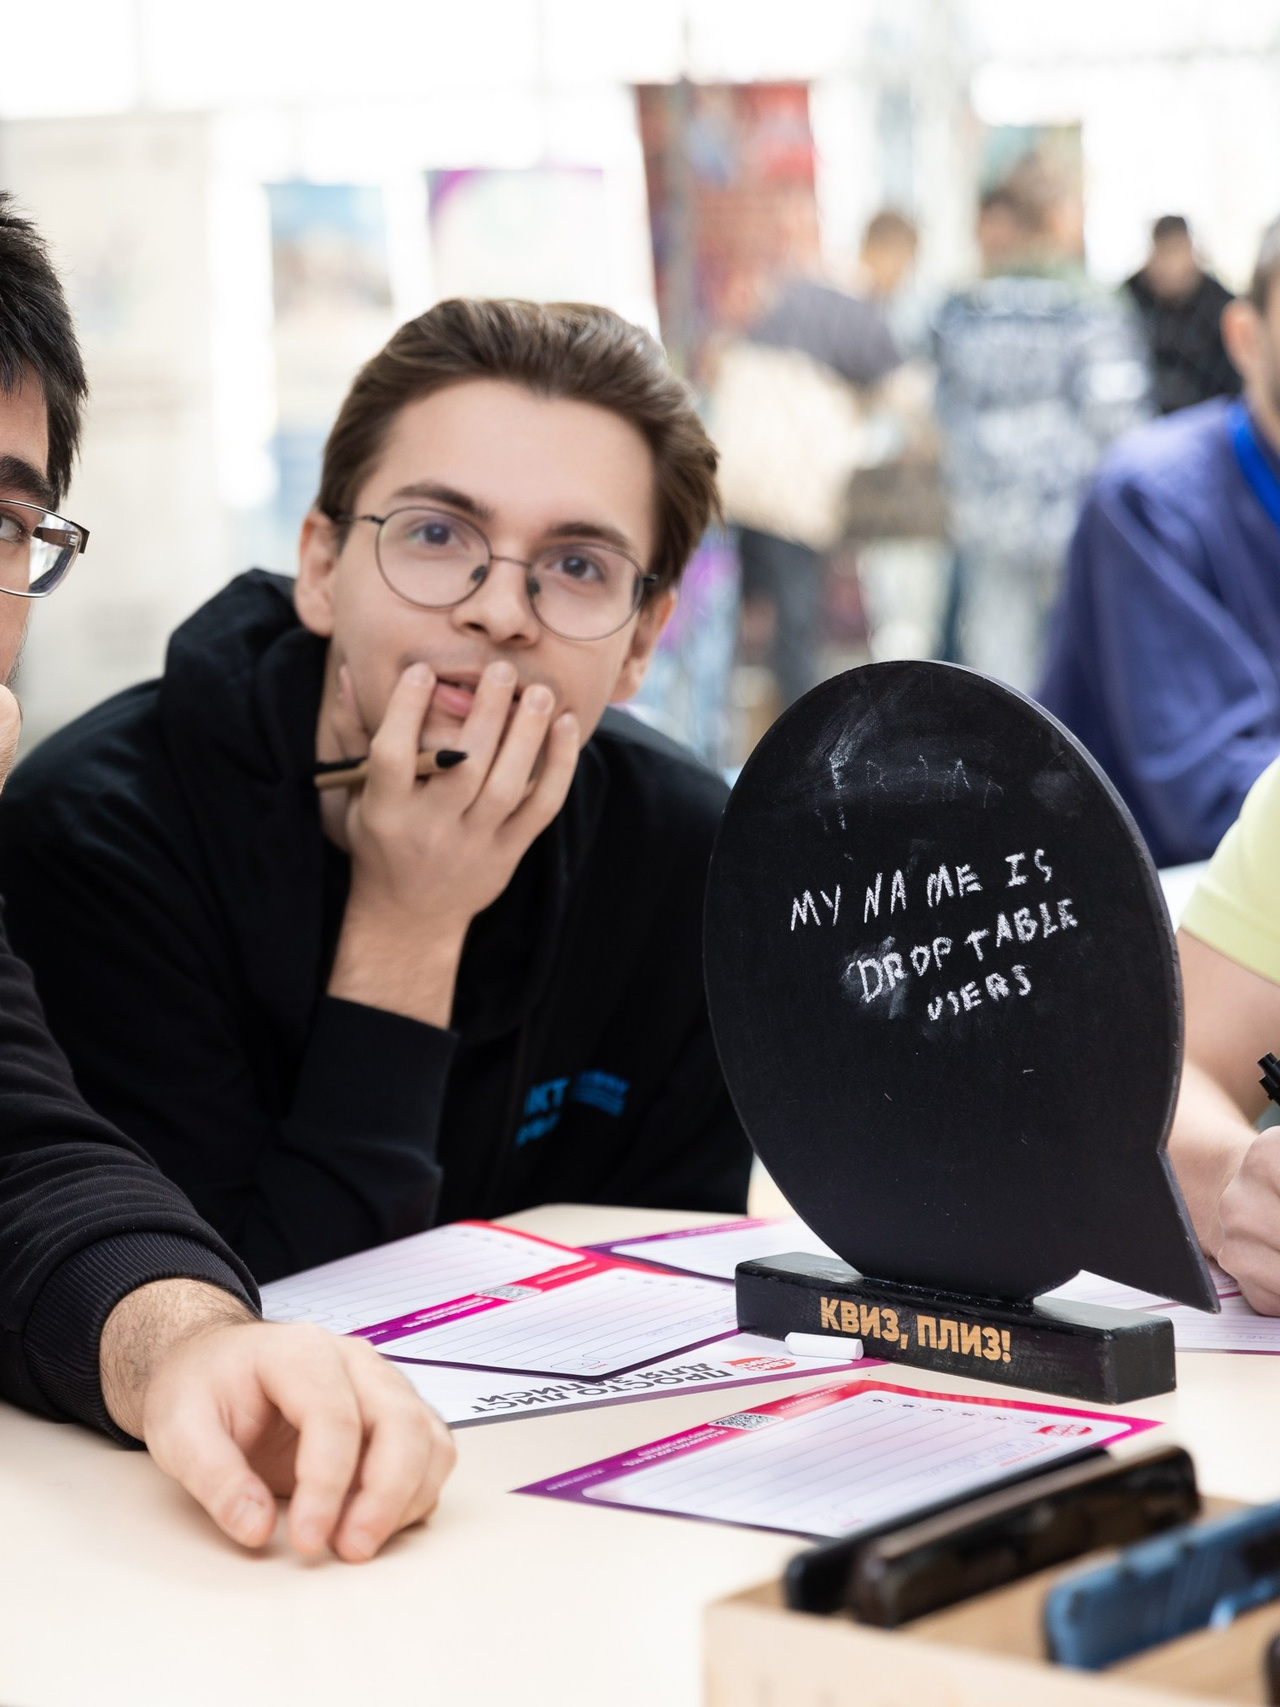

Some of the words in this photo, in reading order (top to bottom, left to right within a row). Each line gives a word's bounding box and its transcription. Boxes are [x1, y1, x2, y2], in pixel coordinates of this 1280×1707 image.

[790, 883, 841, 931] MY
[1005, 848, 1052, 888] IS
[853, 936, 953, 1004] DROP
[964, 897, 1079, 962] TABLE
[820, 1296, 909, 1350] КВИЗ,
[916, 1314, 1012, 1364] ПЛИЗ!
[576, 1369, 734, 1395] ПРОСТО
[634, 1362, 714, 1380] ДЛЯ
[470, 1392, 571, 1413] ЛИСТ
